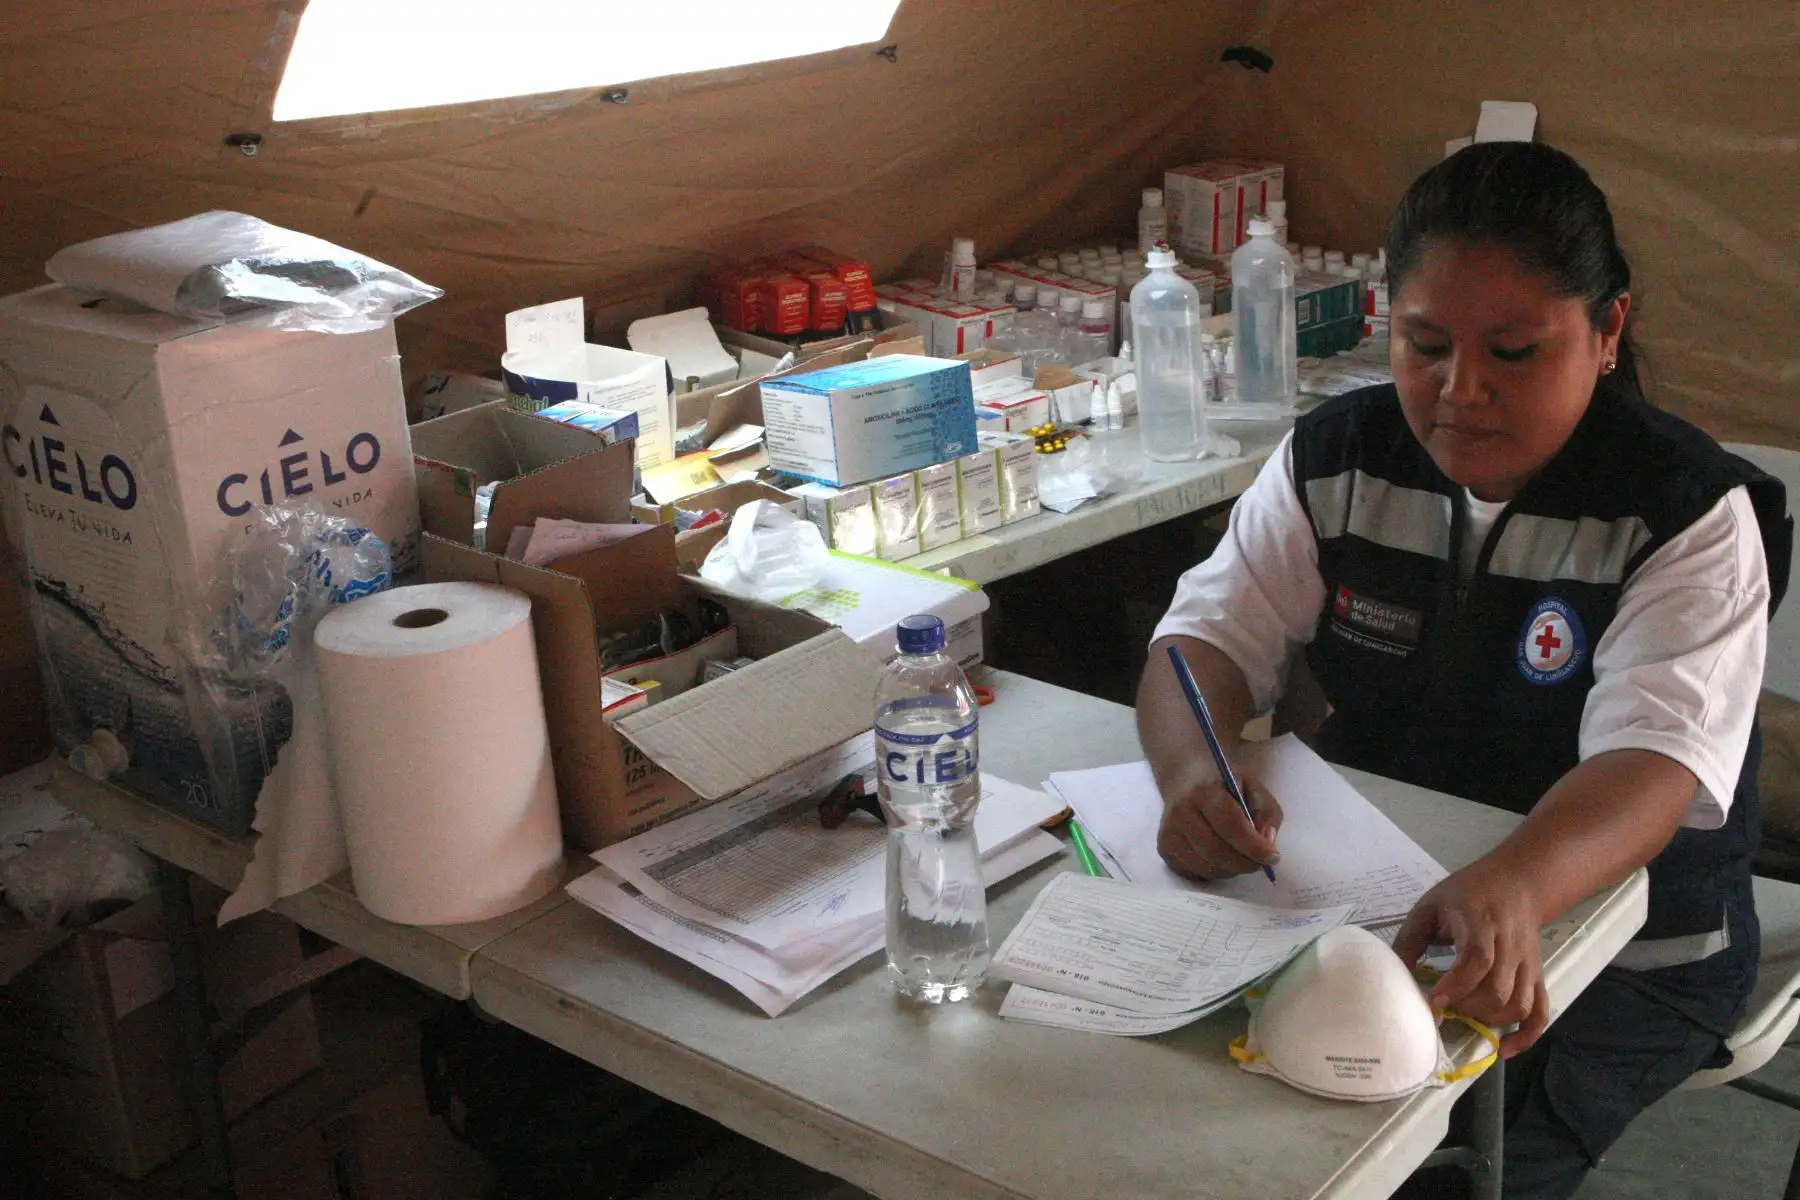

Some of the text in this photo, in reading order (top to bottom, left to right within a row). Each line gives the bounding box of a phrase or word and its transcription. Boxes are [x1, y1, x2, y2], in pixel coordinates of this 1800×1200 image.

[24, 493, 133, 545] ELEVA TU VIDA
[1352, 599, 1416, 625] Ministerio
[1537, 601, 1568, 617] HOSPITAL
[1351, 611, 1395, 632] de Salud
